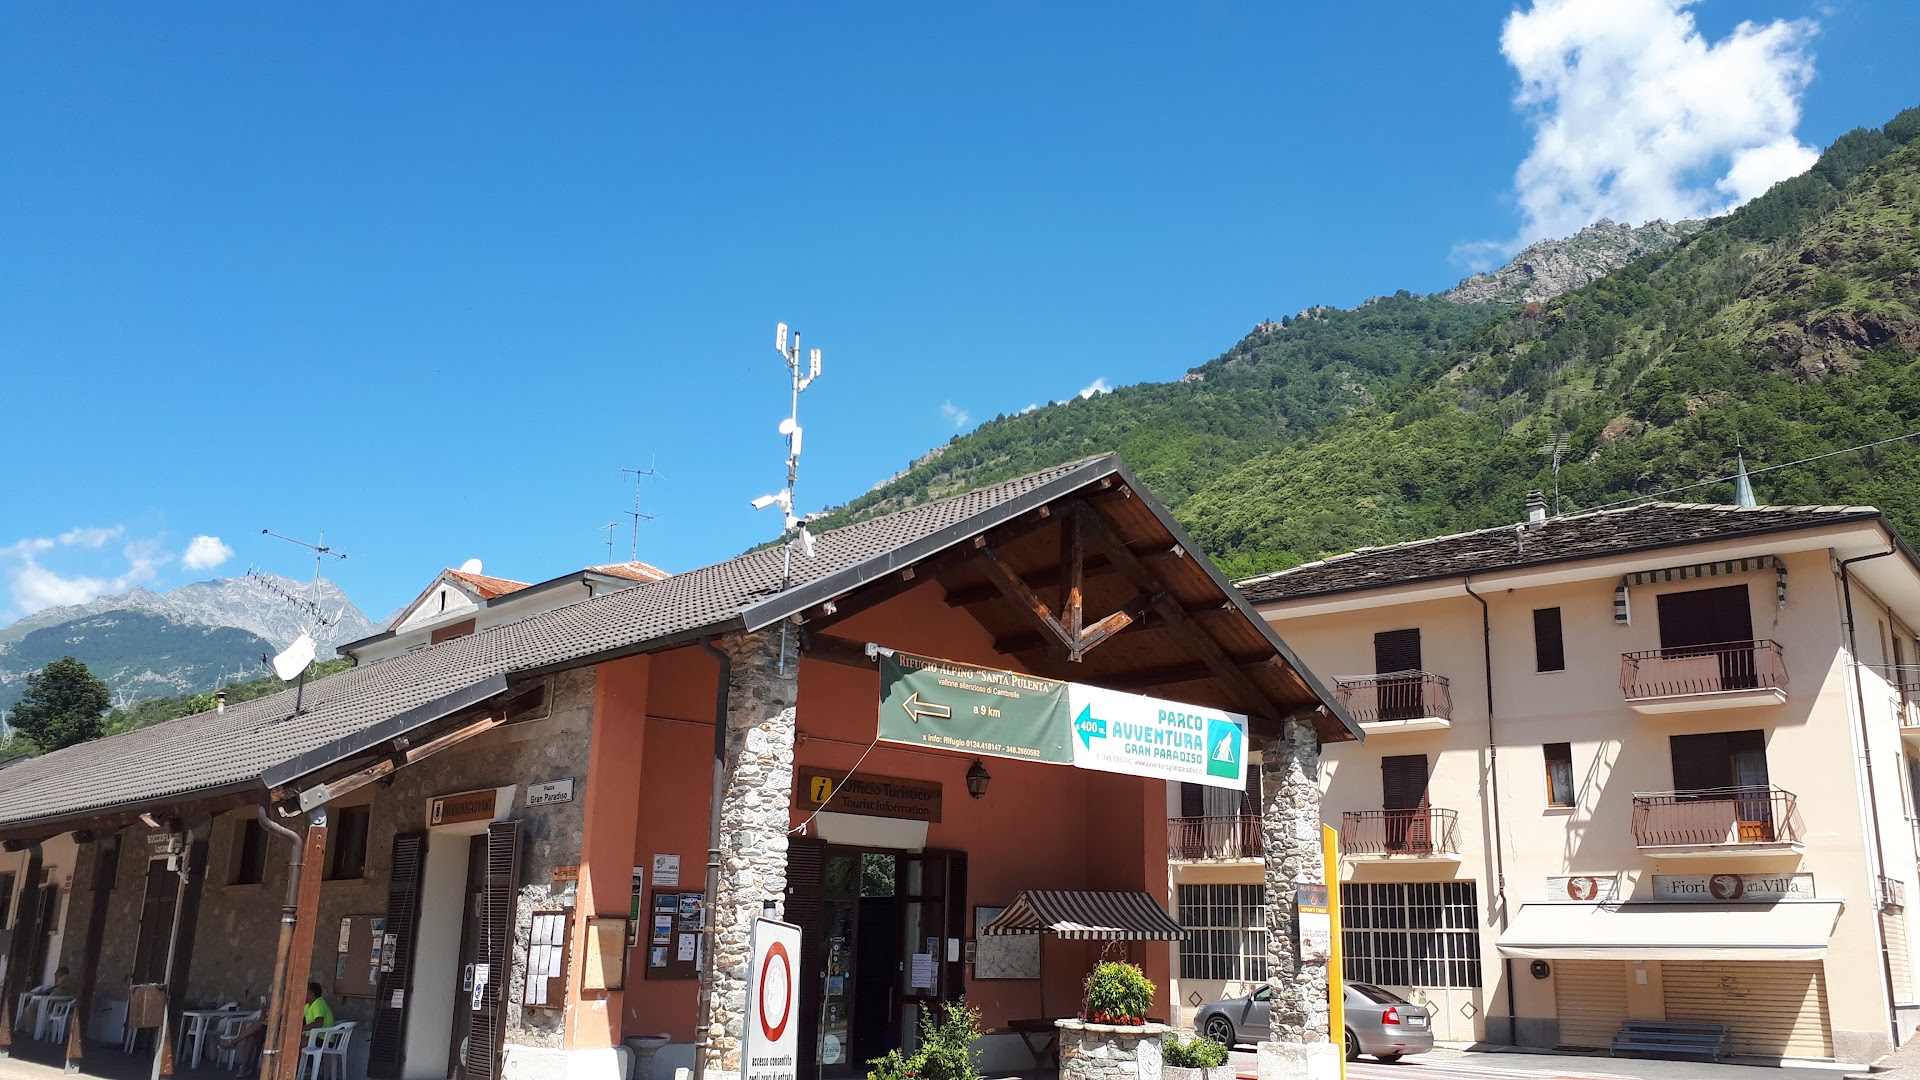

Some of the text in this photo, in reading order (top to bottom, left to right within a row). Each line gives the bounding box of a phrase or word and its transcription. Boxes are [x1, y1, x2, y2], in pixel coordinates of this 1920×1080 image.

[899, 654, 937, 672] RIFUGIO
[940, 663, 974, 680] ALPINO
[938, 679, 958, 688] vallone
[959, 682, 986, 692] silenzioso
[973, 704, 1001, 718] a 9 km
[1081, 720, 1098, 732] 400
[1158, 709, 1203, 731] PARCO
[928, 734, 943, 743] info:
[943, 736, 965, 747] Rifugio
[1112, 721, 1203, 751] AVVENTURA
[1125, 743, 1203, 764] GRAN PARADISO
[842, 779, 931, 801] Ufficio Turistico
[530, 791, 568, 804] Gran Paradiso
[842, 796, 930, 816] Tourist Information
[1671, 880, 1706, 893] Fiori
[1762, 879, 1799, 893] Villa
[752, 1054, 791, 1066] accesso consentito
